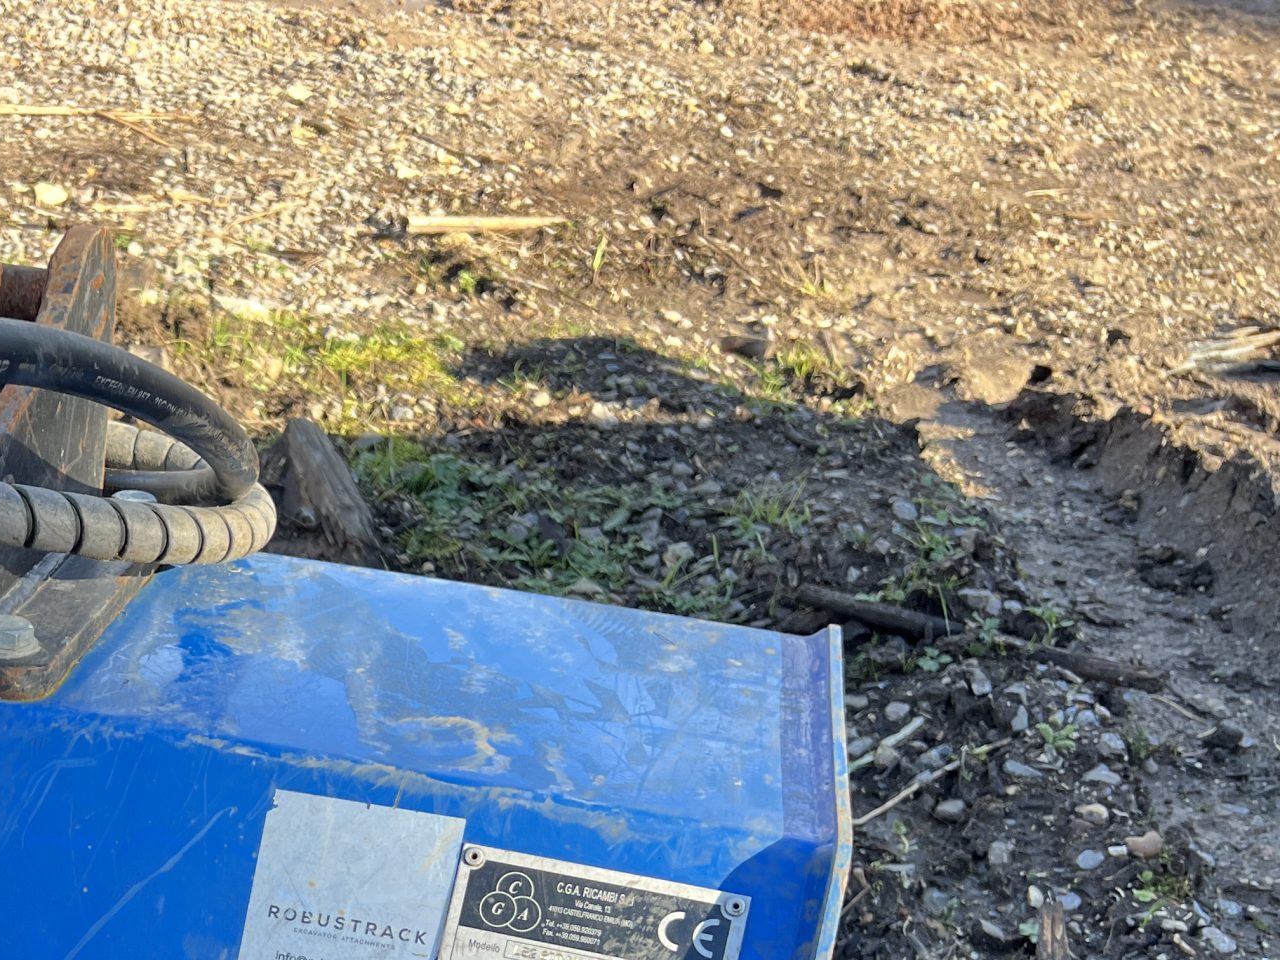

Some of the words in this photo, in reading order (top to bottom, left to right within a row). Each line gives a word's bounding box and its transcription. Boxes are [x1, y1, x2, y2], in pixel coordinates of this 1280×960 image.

[96, 375, 125, 393] EXCEED
[582, 887, 618, 903] RICAMBI
[574, 899, 584, 908] Via
[562, 907, 603, 922] CASTELFRANCO
[267, 904, 428, 946] ROBUSTRACK
[293, 927, 337, 940] EXCAVATOR
[341, 936, 396, 950] ATTACHMENTS
[468, 938, 501, 953] Modello
